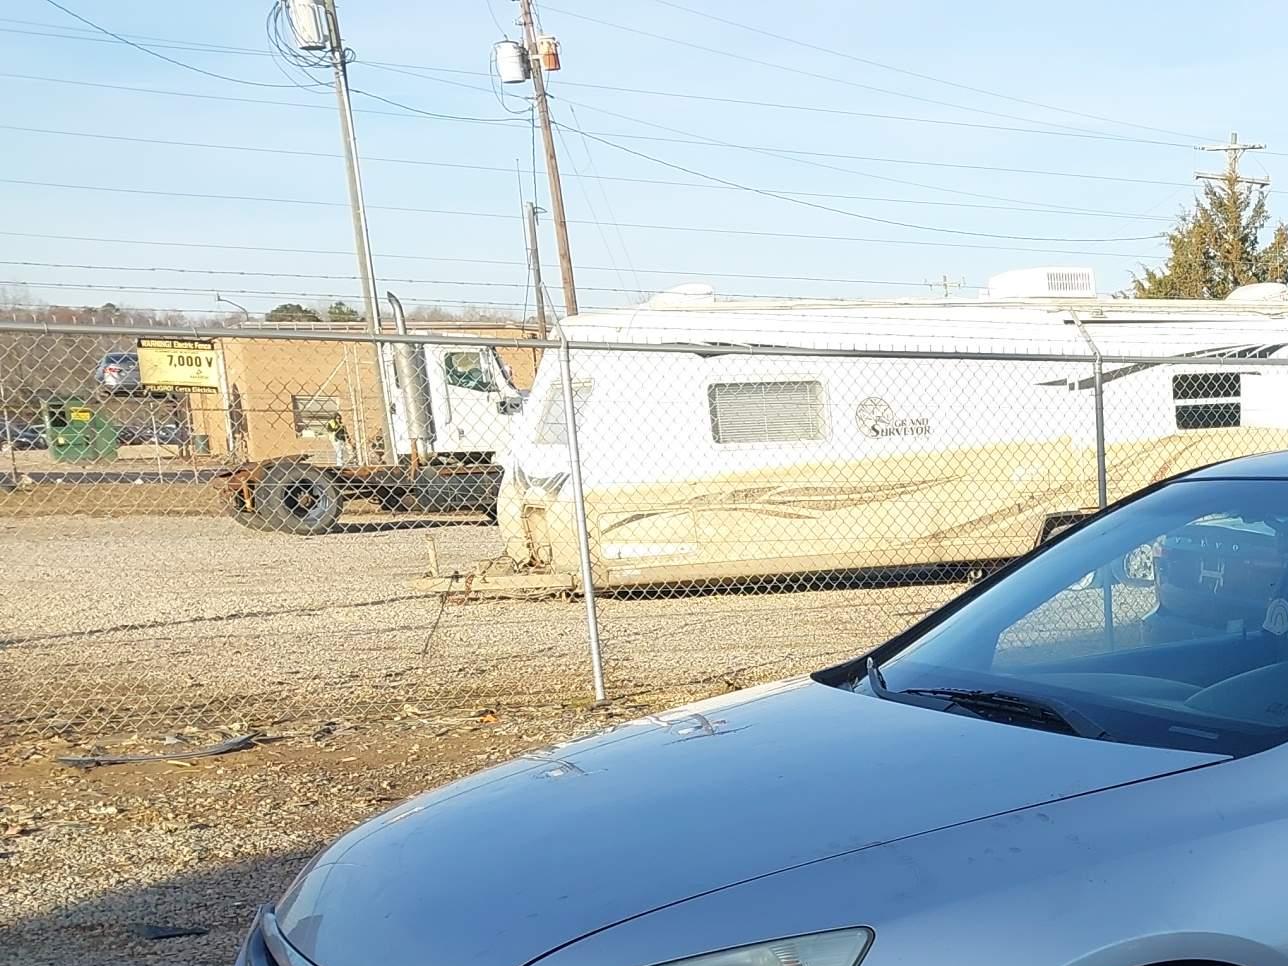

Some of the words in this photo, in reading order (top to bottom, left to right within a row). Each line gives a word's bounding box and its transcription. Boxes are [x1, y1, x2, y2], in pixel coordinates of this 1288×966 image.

[173, 341, 194, 349] Electric
[167, 355, 202, 368] 7,000
[205, 356, 213, 368] V
[894, 418, 929, 428] GRAND
[871, 423, 931, 438] SURVEYOR
